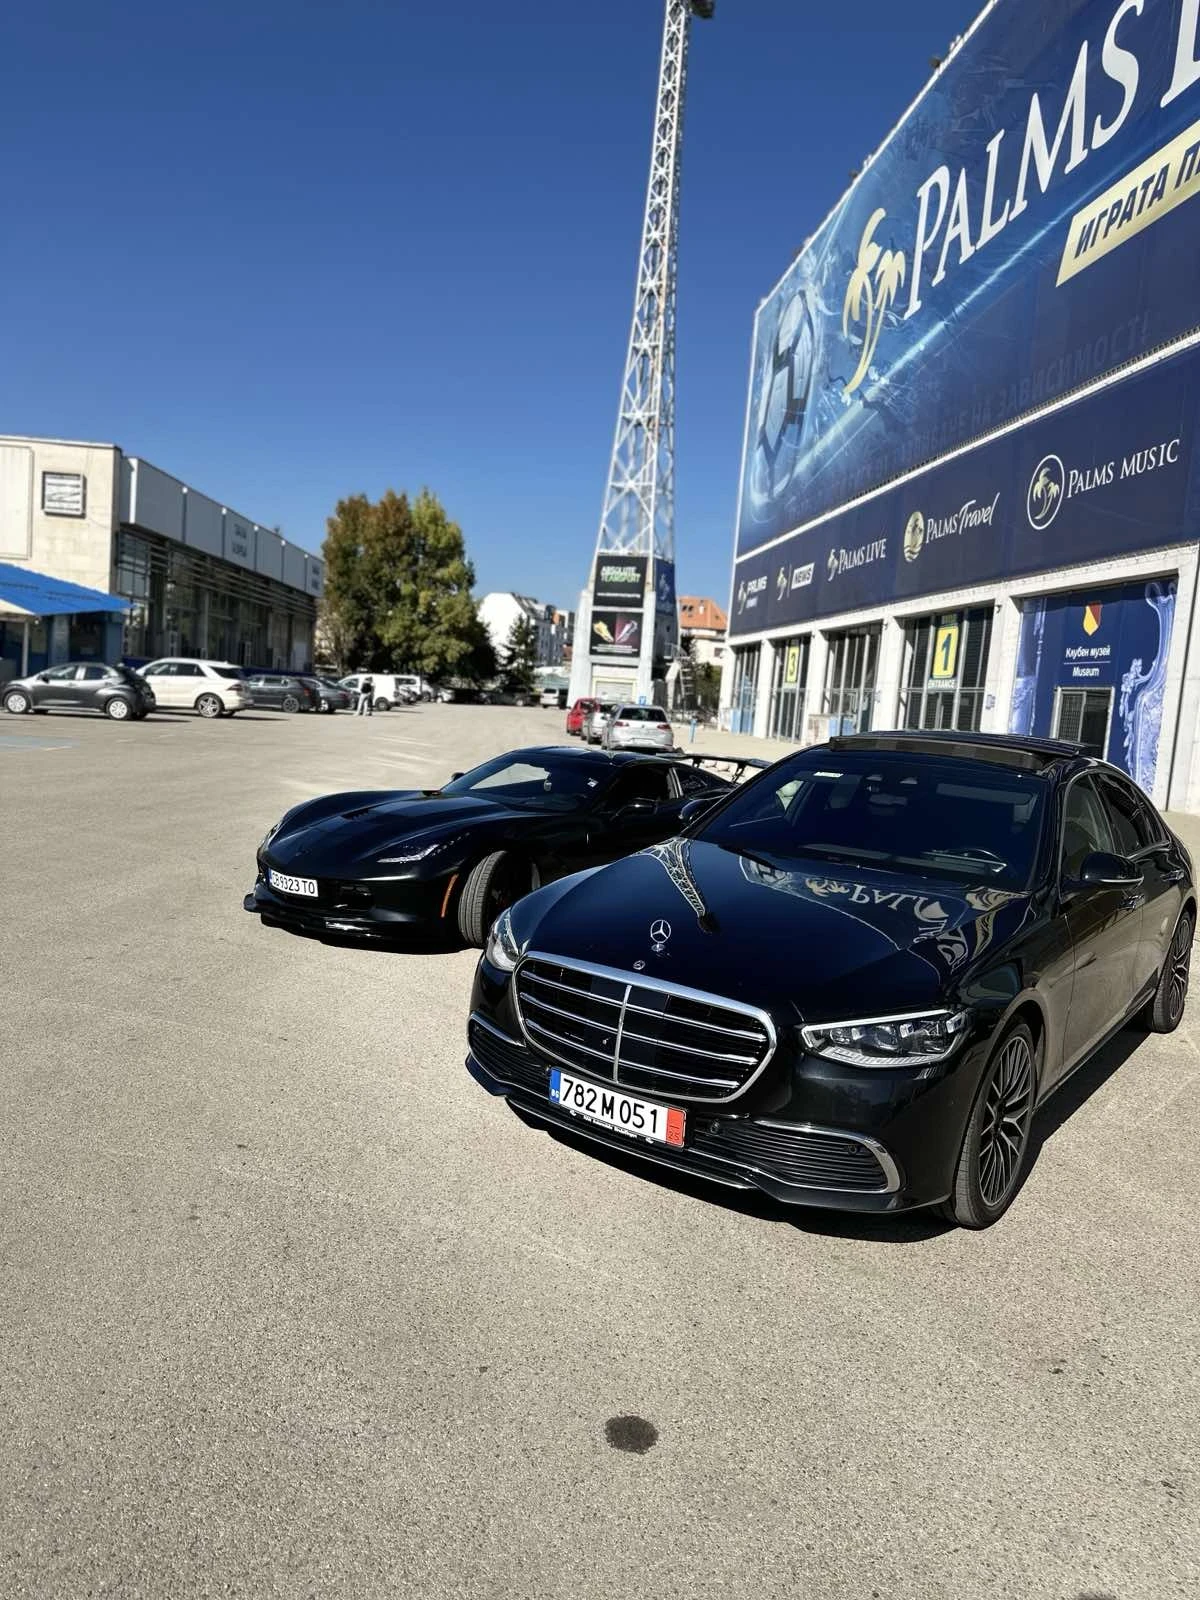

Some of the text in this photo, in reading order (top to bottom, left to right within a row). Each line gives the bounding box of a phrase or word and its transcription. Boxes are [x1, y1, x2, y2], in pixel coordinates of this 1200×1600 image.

[904, 0, 1144, 320] PALMS
[1074, 163, 1170, 259] ИГРАТА
[1067, 439, 1180, 498] PALMS MUSIC
[926, 492, 1000, 544] PALMS Travel
[838, 539, 887, 574] PALMS LIVE
[790, 652, 796, 676] 3
[941, 633, 952, 671] 1
[1065, 644, 1111, 660] Клубен музей
[1072, 666, 1100, 677] Museum
